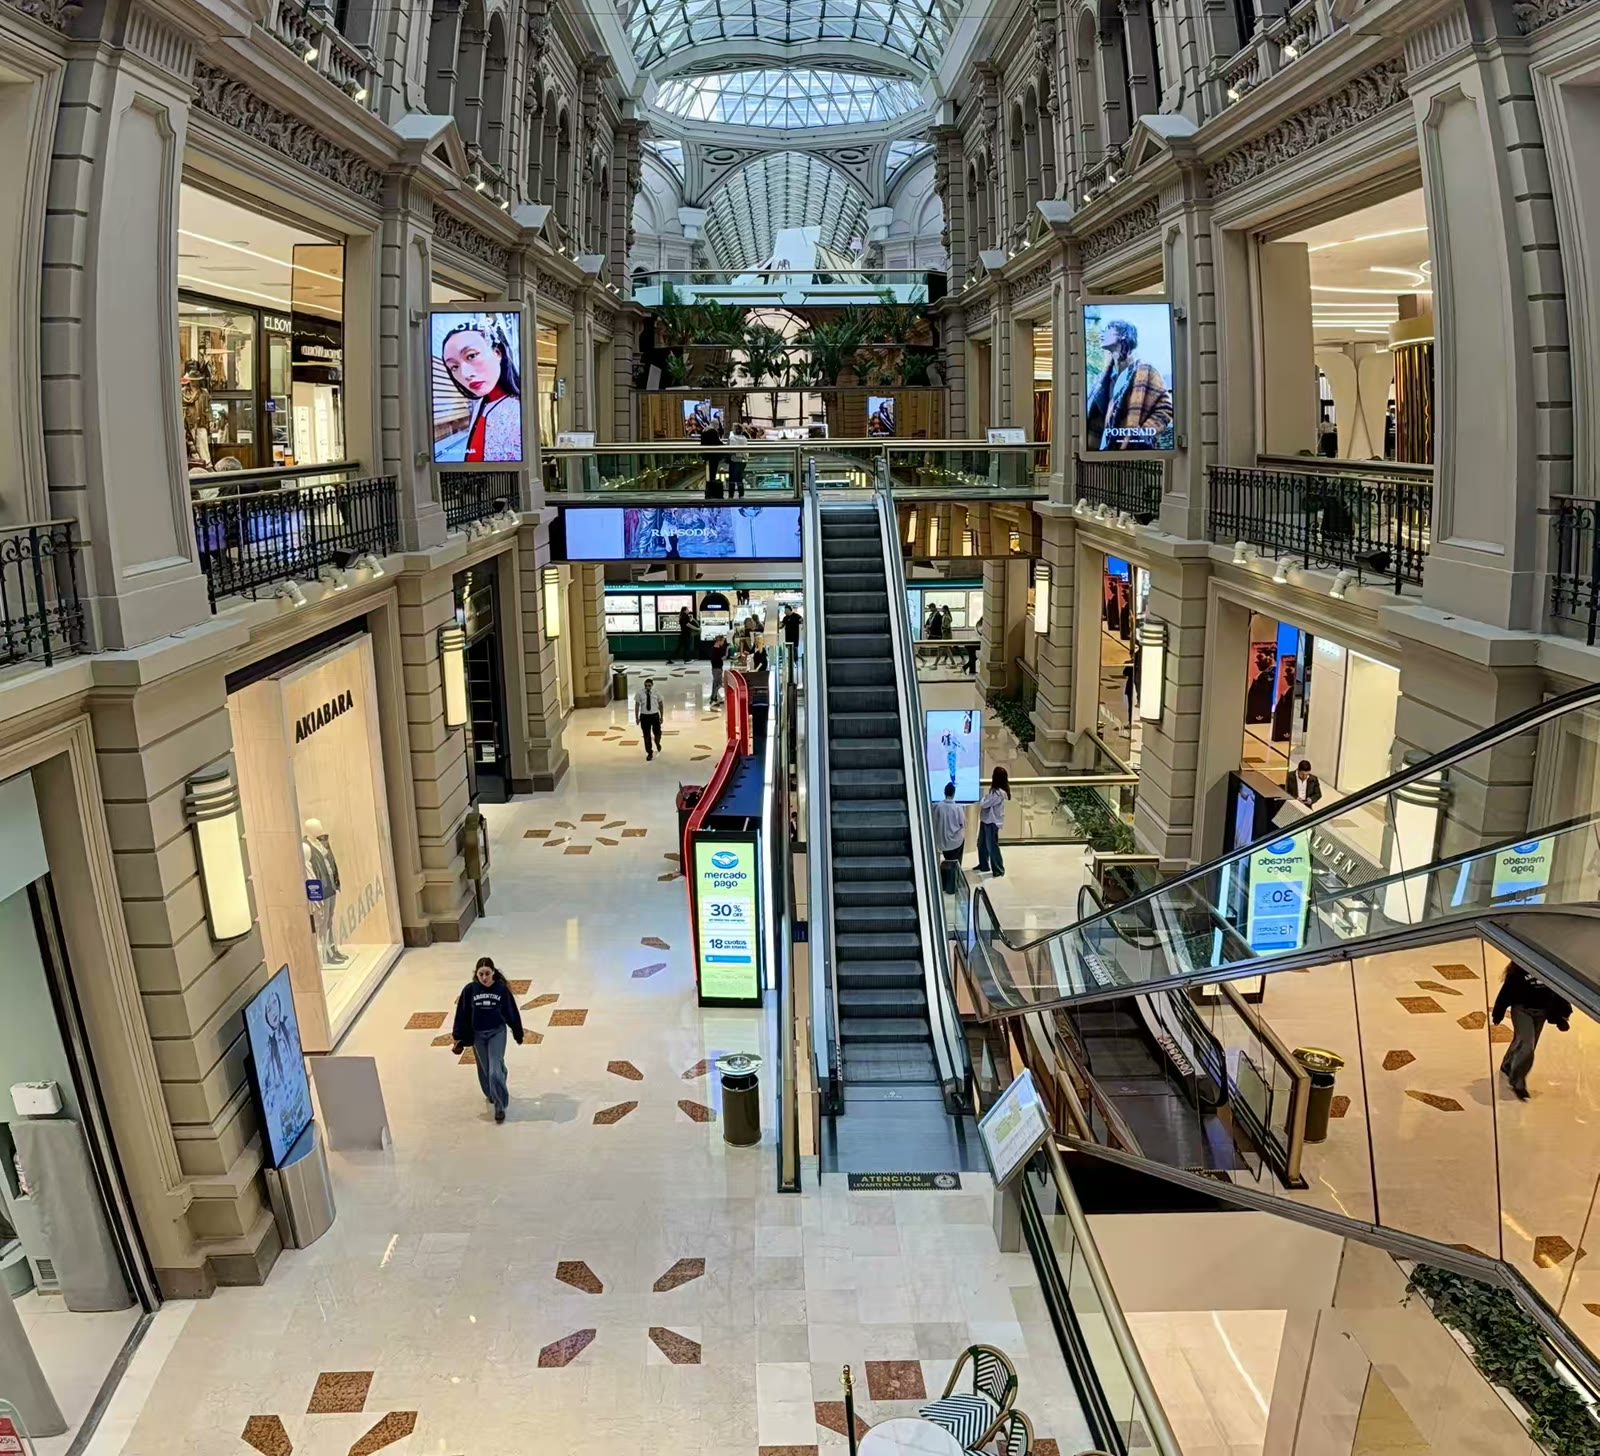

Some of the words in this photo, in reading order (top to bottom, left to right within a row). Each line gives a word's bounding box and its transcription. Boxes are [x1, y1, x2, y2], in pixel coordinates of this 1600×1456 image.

[1105, 427, 1157, 437] PORTSAID
[296, 689, 354, 744] AKIABARA
[1307, 828, 1357, 874] LDEN
[704, 871, 747, 879] mercado
[713, 880, 738, 889] pago
[339, 873, 384, 946] ABARA
[709, 938, 723, 949] 18
